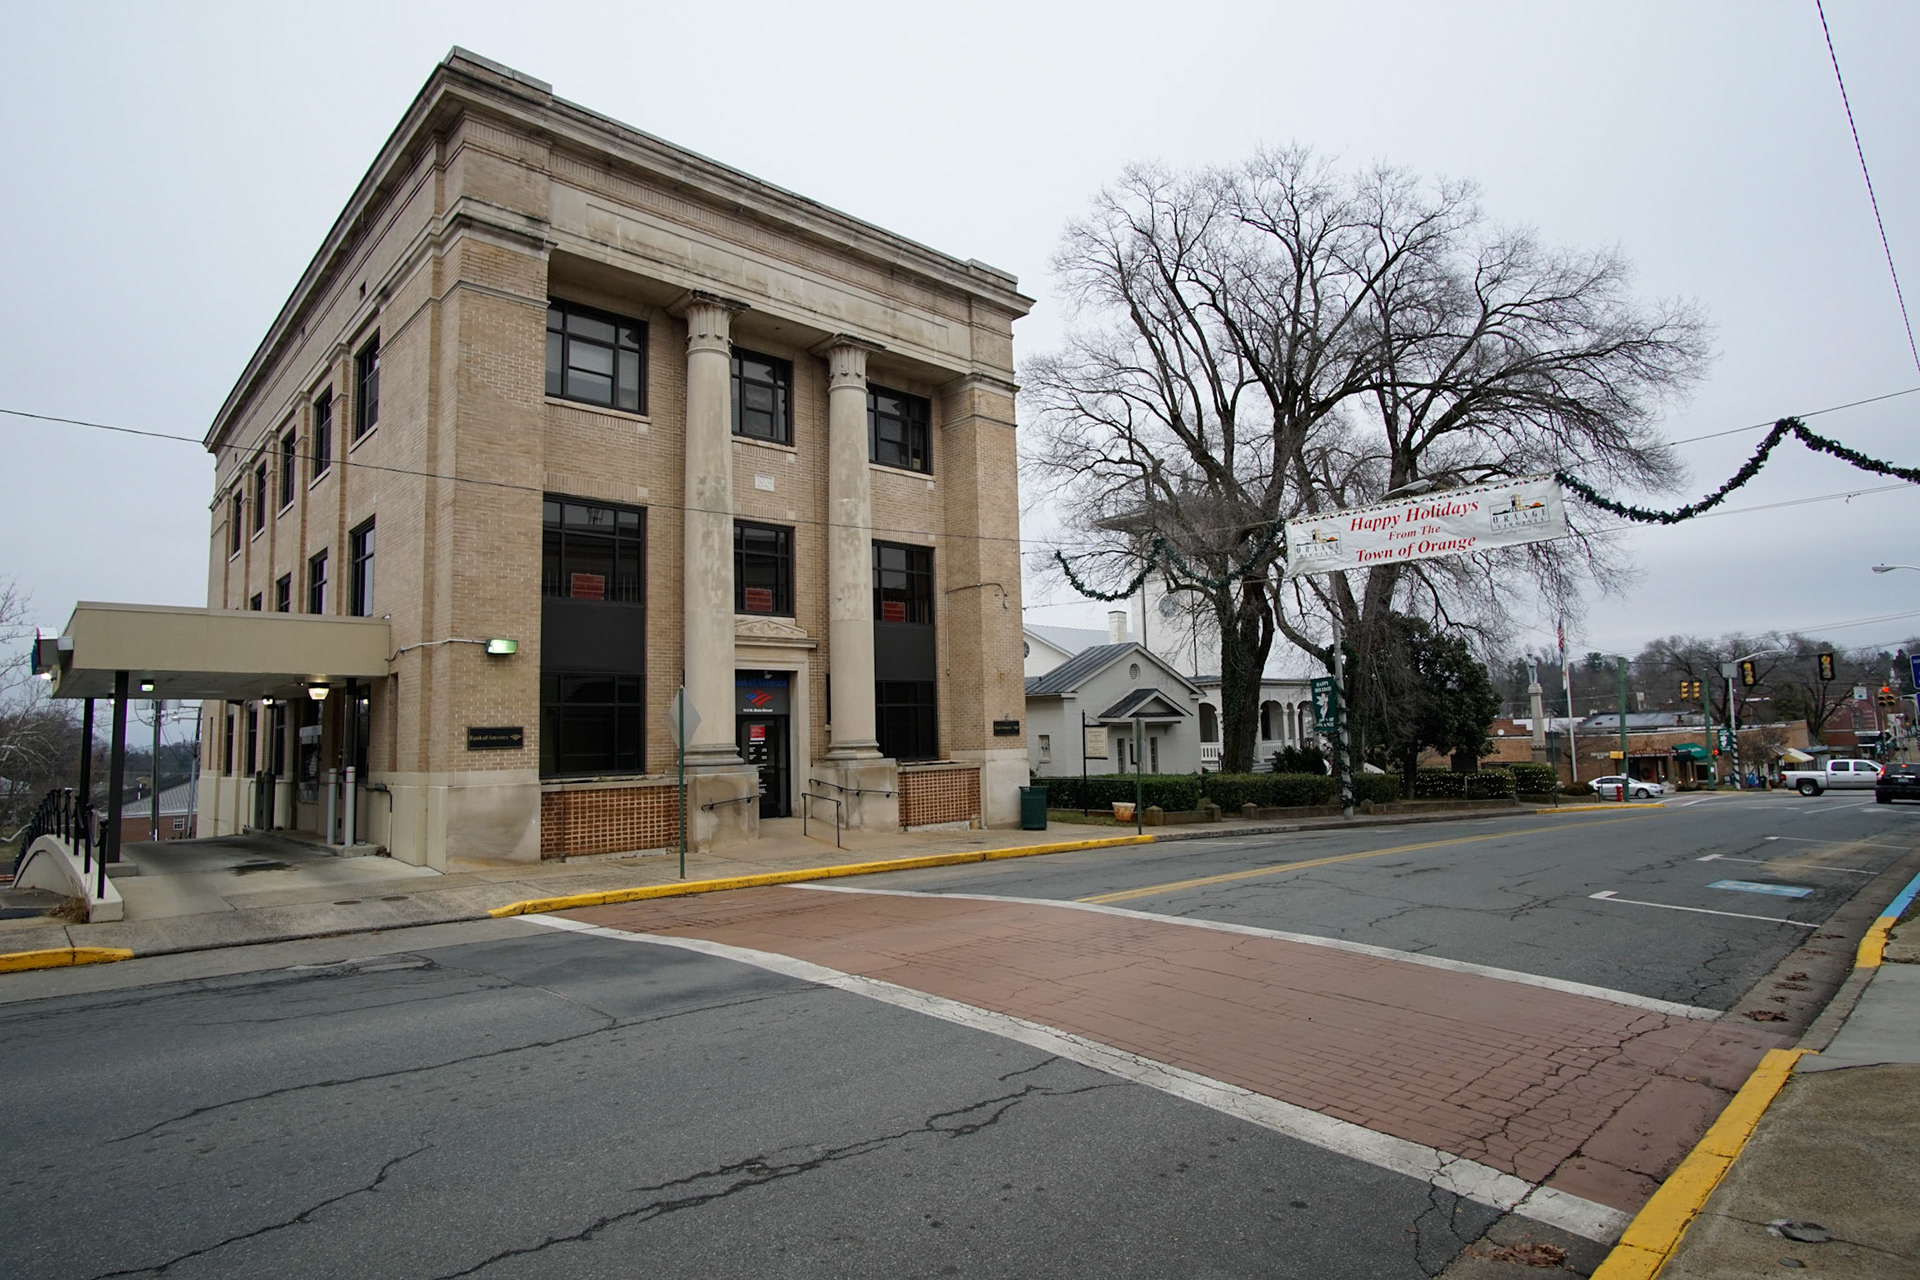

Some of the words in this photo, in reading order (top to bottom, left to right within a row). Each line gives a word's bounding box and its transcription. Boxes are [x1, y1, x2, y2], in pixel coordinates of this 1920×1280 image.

[1350, 514, 1401, 532] Happy
[1406, 501, 1479, 523] Holidays
[1492, 508, 1547, 524] ORANGE
[1388, 530, 1417, 541] From
[1420, 525, 1441, 536] The
[1356, 548, 1393, 562] Town
[1398, 541, 1415, 559] of
[1418, 536, 1476, 554] Orange
